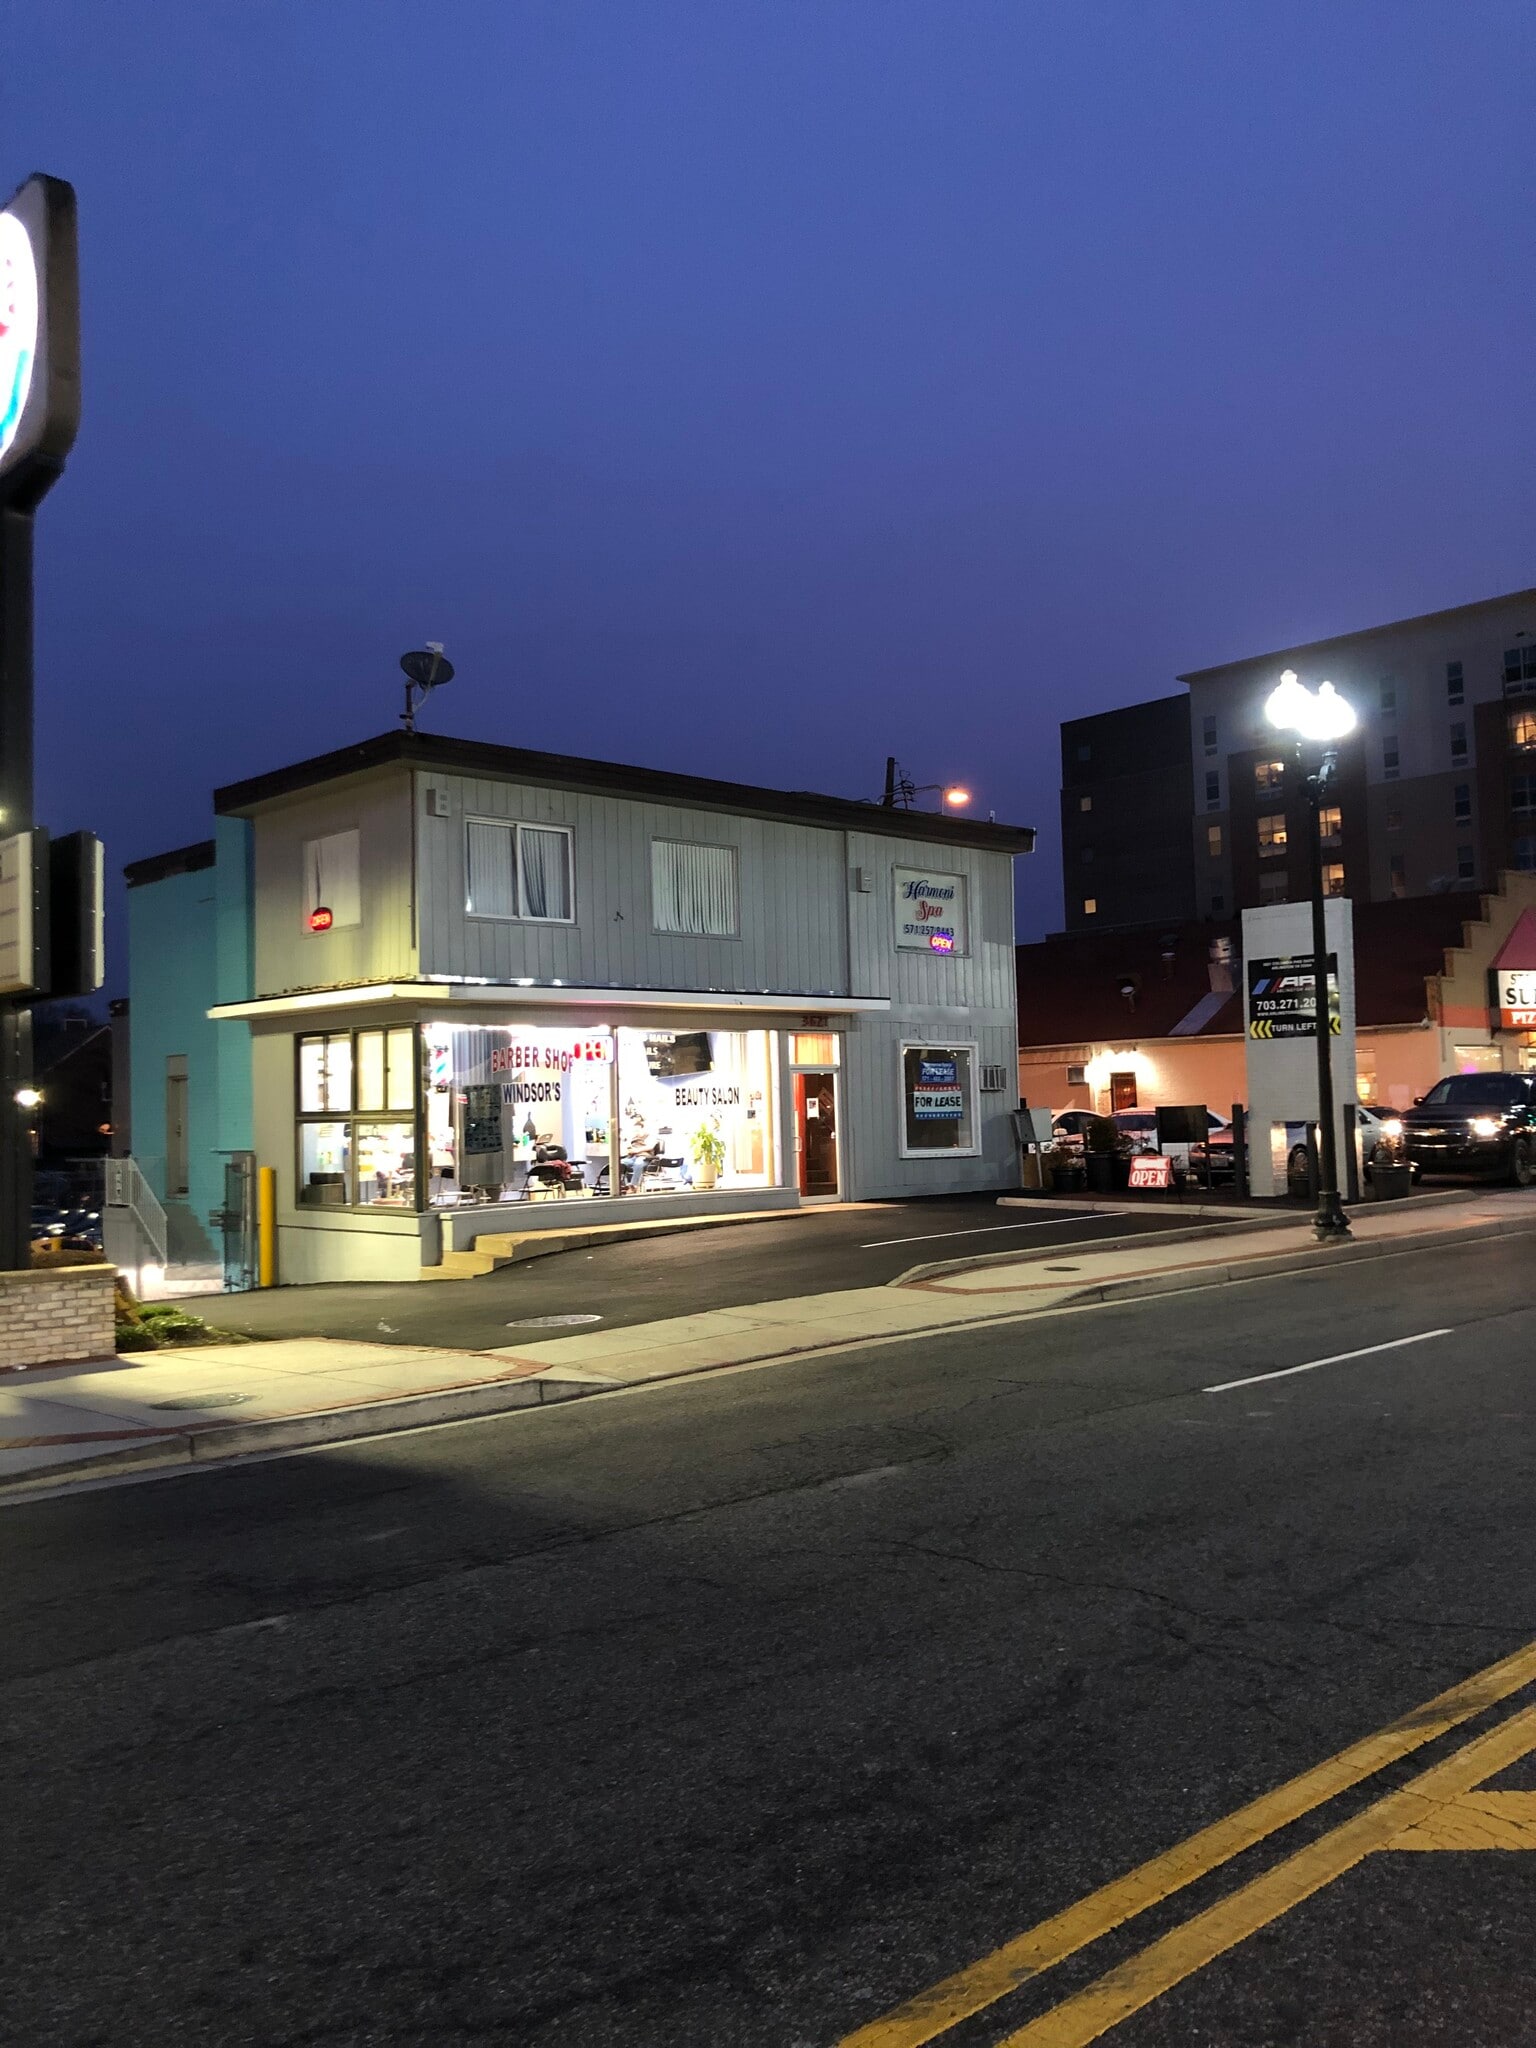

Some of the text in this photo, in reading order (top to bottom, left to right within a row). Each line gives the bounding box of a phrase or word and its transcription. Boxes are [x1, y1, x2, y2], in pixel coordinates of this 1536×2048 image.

[903, 880, 955, 900] Harmoni
[915, 900, 943, 922] Spa
[931, 936, 953, 950] OPEN
[1256, 997, 1317, 1010] 703.271.20
[1506, 987, 1536, 1005] SU
[1271, 1022, 1317, 1032] TURN LEFT
[492, 1045, 539, 1074] BARBER
[502, 1081, 561, 1104] WINDSOR'S
[675, 1087, 740, 1106] BEAUTY SALON
[915, 1096, 961, 1108] FOR LEASE
[1131, 1170, 1167, 1186] OPEN
